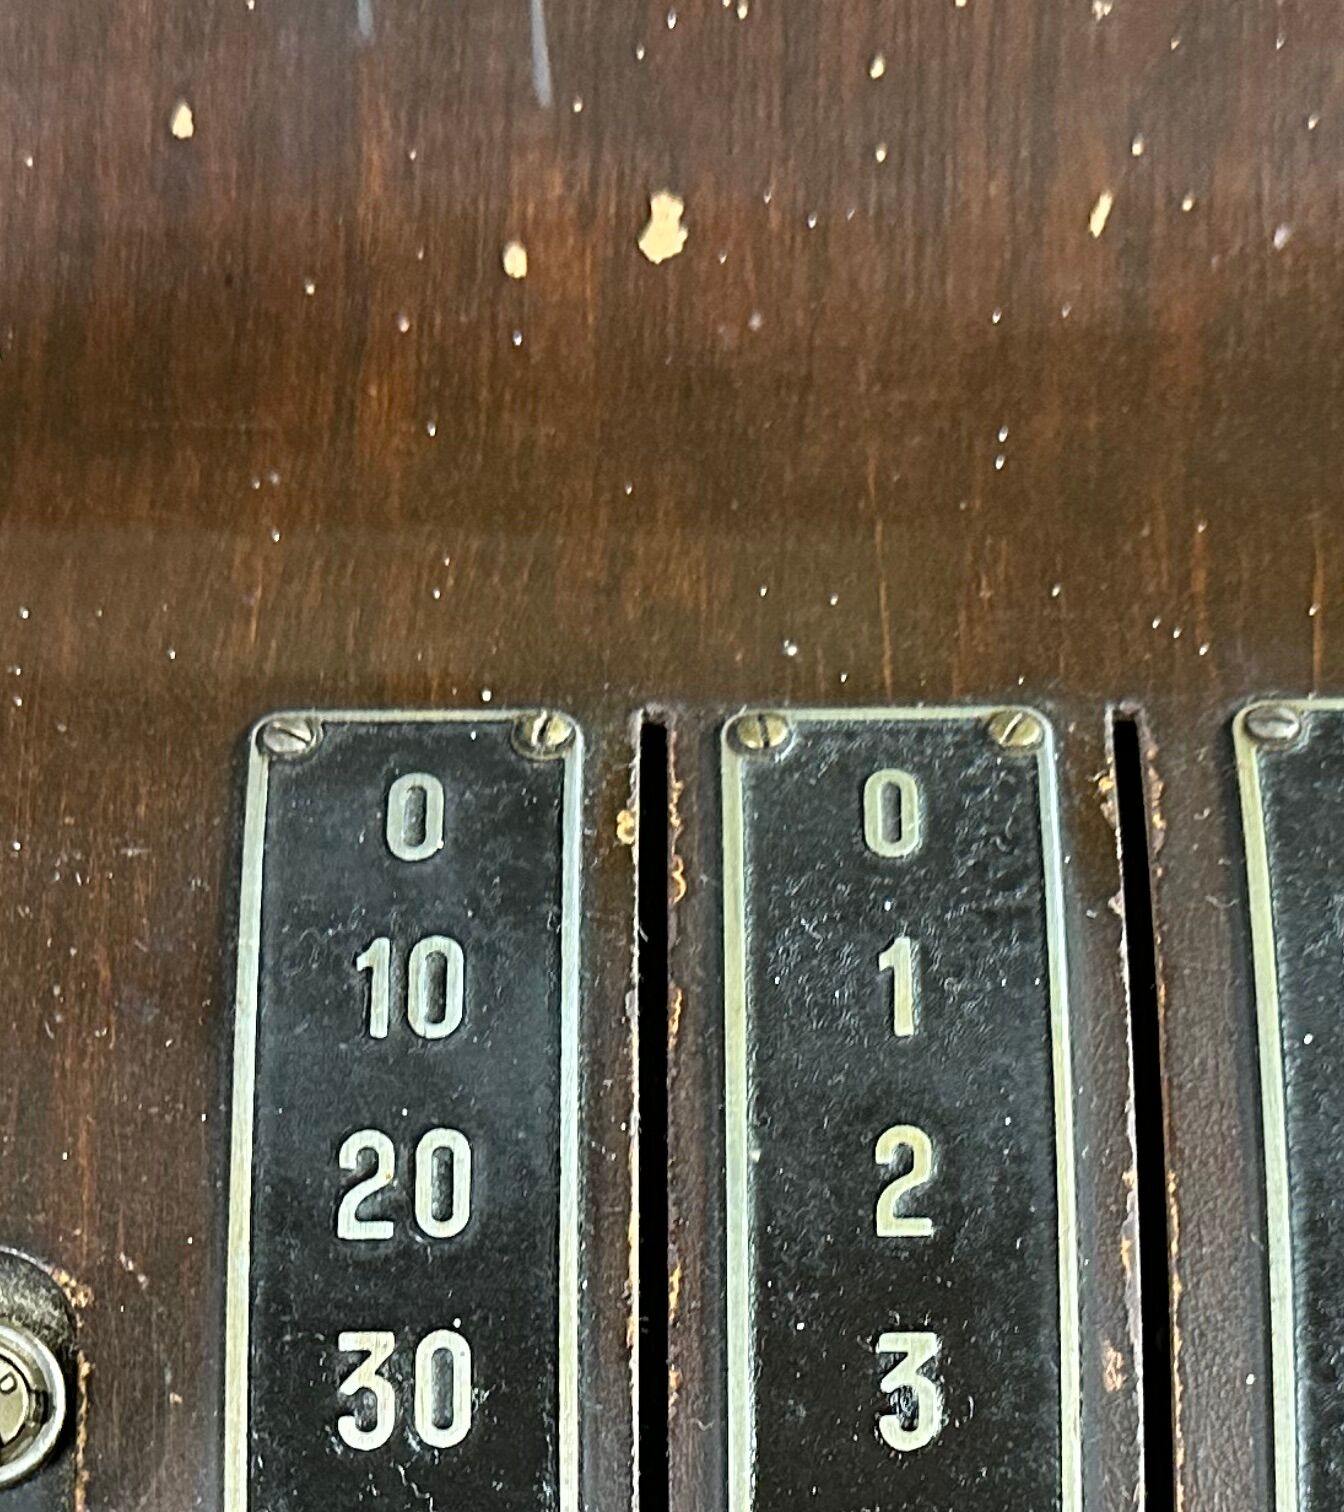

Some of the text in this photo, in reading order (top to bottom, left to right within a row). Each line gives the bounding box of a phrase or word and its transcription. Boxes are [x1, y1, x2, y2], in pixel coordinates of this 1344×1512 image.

[386, 772, 445, 863] 0
[862, 769, 921, 859] 0
[355, 936, 465, 1041] 10
[879, 936, 918, 1038] 1
[336, 1127, 473, 1241] 20
[875, 1124, 934, 1238] 2
[336, 1329, 473, 1452] 30
[875, 1331, 943, 1452] 3
